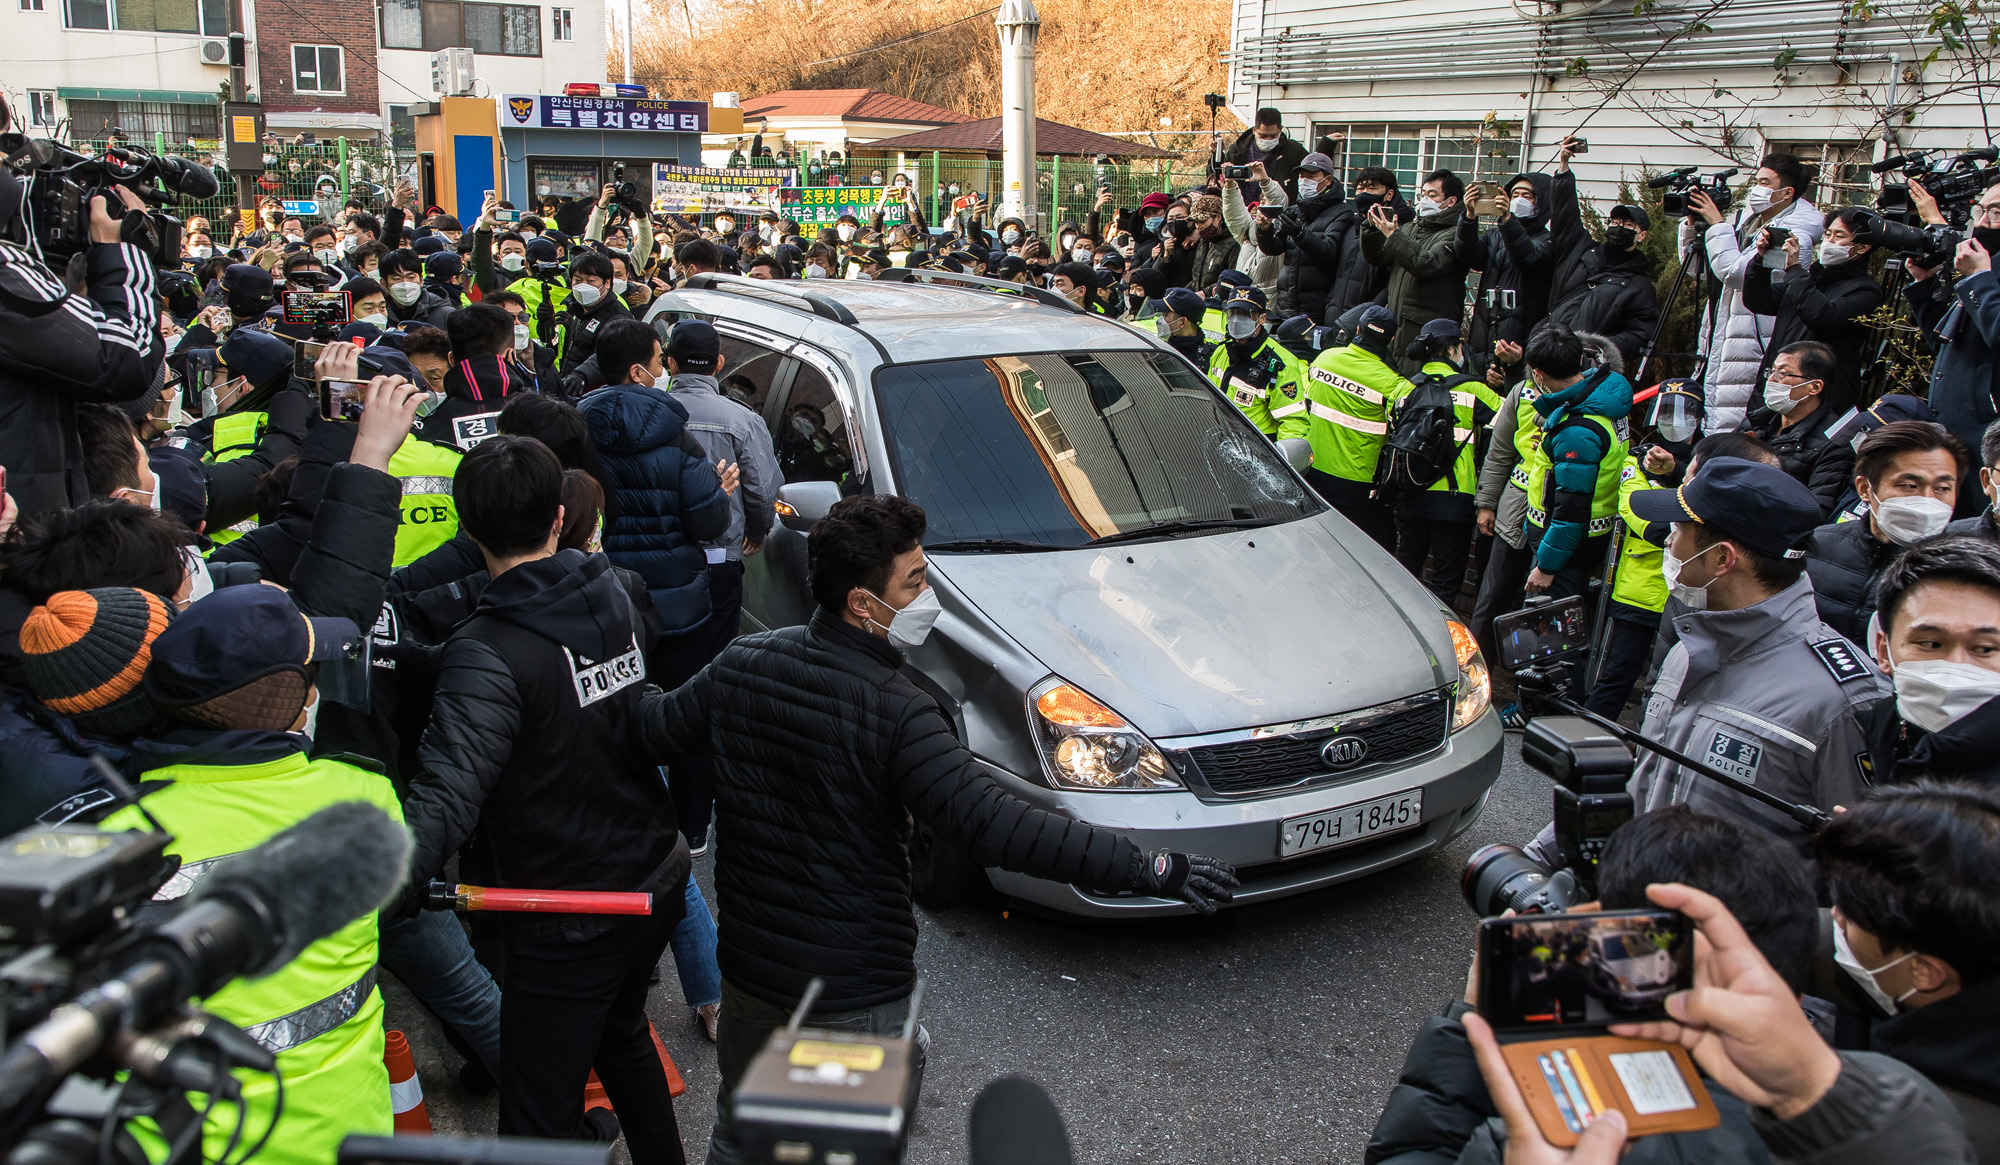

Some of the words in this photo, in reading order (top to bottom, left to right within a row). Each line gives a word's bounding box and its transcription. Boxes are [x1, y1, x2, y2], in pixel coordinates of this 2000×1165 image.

[551, 97, 624, 109] 안산단원경찰서
[636, 101, 669, 109] POLICE
[551, 109, 700, 131] 특별치안센터
[802, 189, 836, 205] 초등생
[838, 189, 871, 205] 성폭행
[781, 206, 814, 222] 조두순
[815, 206, 837, 222] 출소
[798, 223, 819, 239] 경찰
[1316, 370, 1366, 397] POLICE
[580, 656, 640, 698] POLICE
[1329, 741, 1364, 763] KIA
[1715, 735, 1756, 765] 경찰
[1708, 755, 1752, 779] POLICE
[1296, 816, 1342, 849] 79너
[1355, 798, 1410, 834] 1845
